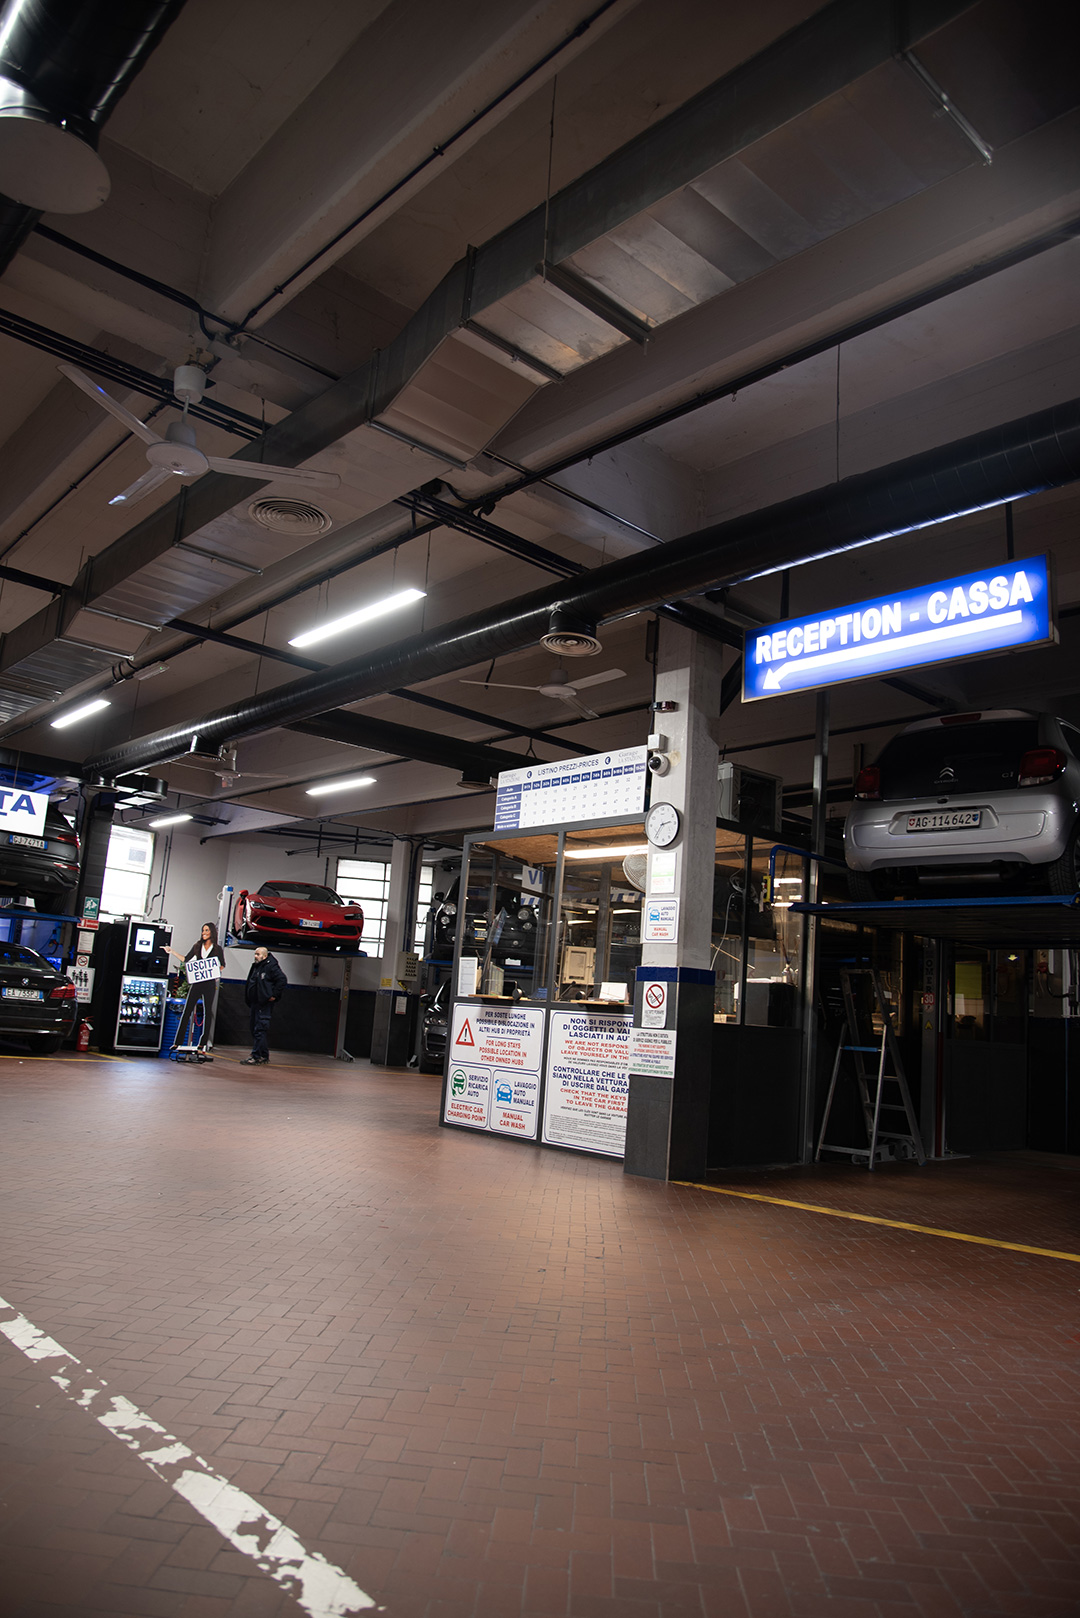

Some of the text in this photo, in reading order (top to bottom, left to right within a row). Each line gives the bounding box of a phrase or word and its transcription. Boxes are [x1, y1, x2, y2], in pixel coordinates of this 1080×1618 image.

[756, 602, 902, 664] RECEPTION
[927, 570, 1034, 624] CASSA
[538, 759, 599, 776] LISTINO PREZZI-PRICES
[187, 959, 218, 972] USCITA
[194, 969, 213, 980] EXIT
[498, 1020, 528, 1028] DISLOCAZIONE
[553, 1066, 600, 1076] CONTROLLARE
[468, 1075, 488, 1083] SERVIZIO
[574, 1075, 594, 1083] NELLA
[596, 1077, 628, 1087] VETTURA
[468, 1082, 488, 1091] RICARICA
[514, 1081, 536, 1090] LAVAGGIO
[570, 1081, 594, 1090] USCIRE
[513, 1098, 534, 1106] MANUALE
[451, 1103, 472, 1112] ELECTRIC
[447, 1110, 470, 1120] CHARGING
[502, 1112, 523, 1121] MANUAL
[511, 1122, 526, 1130] WASH
